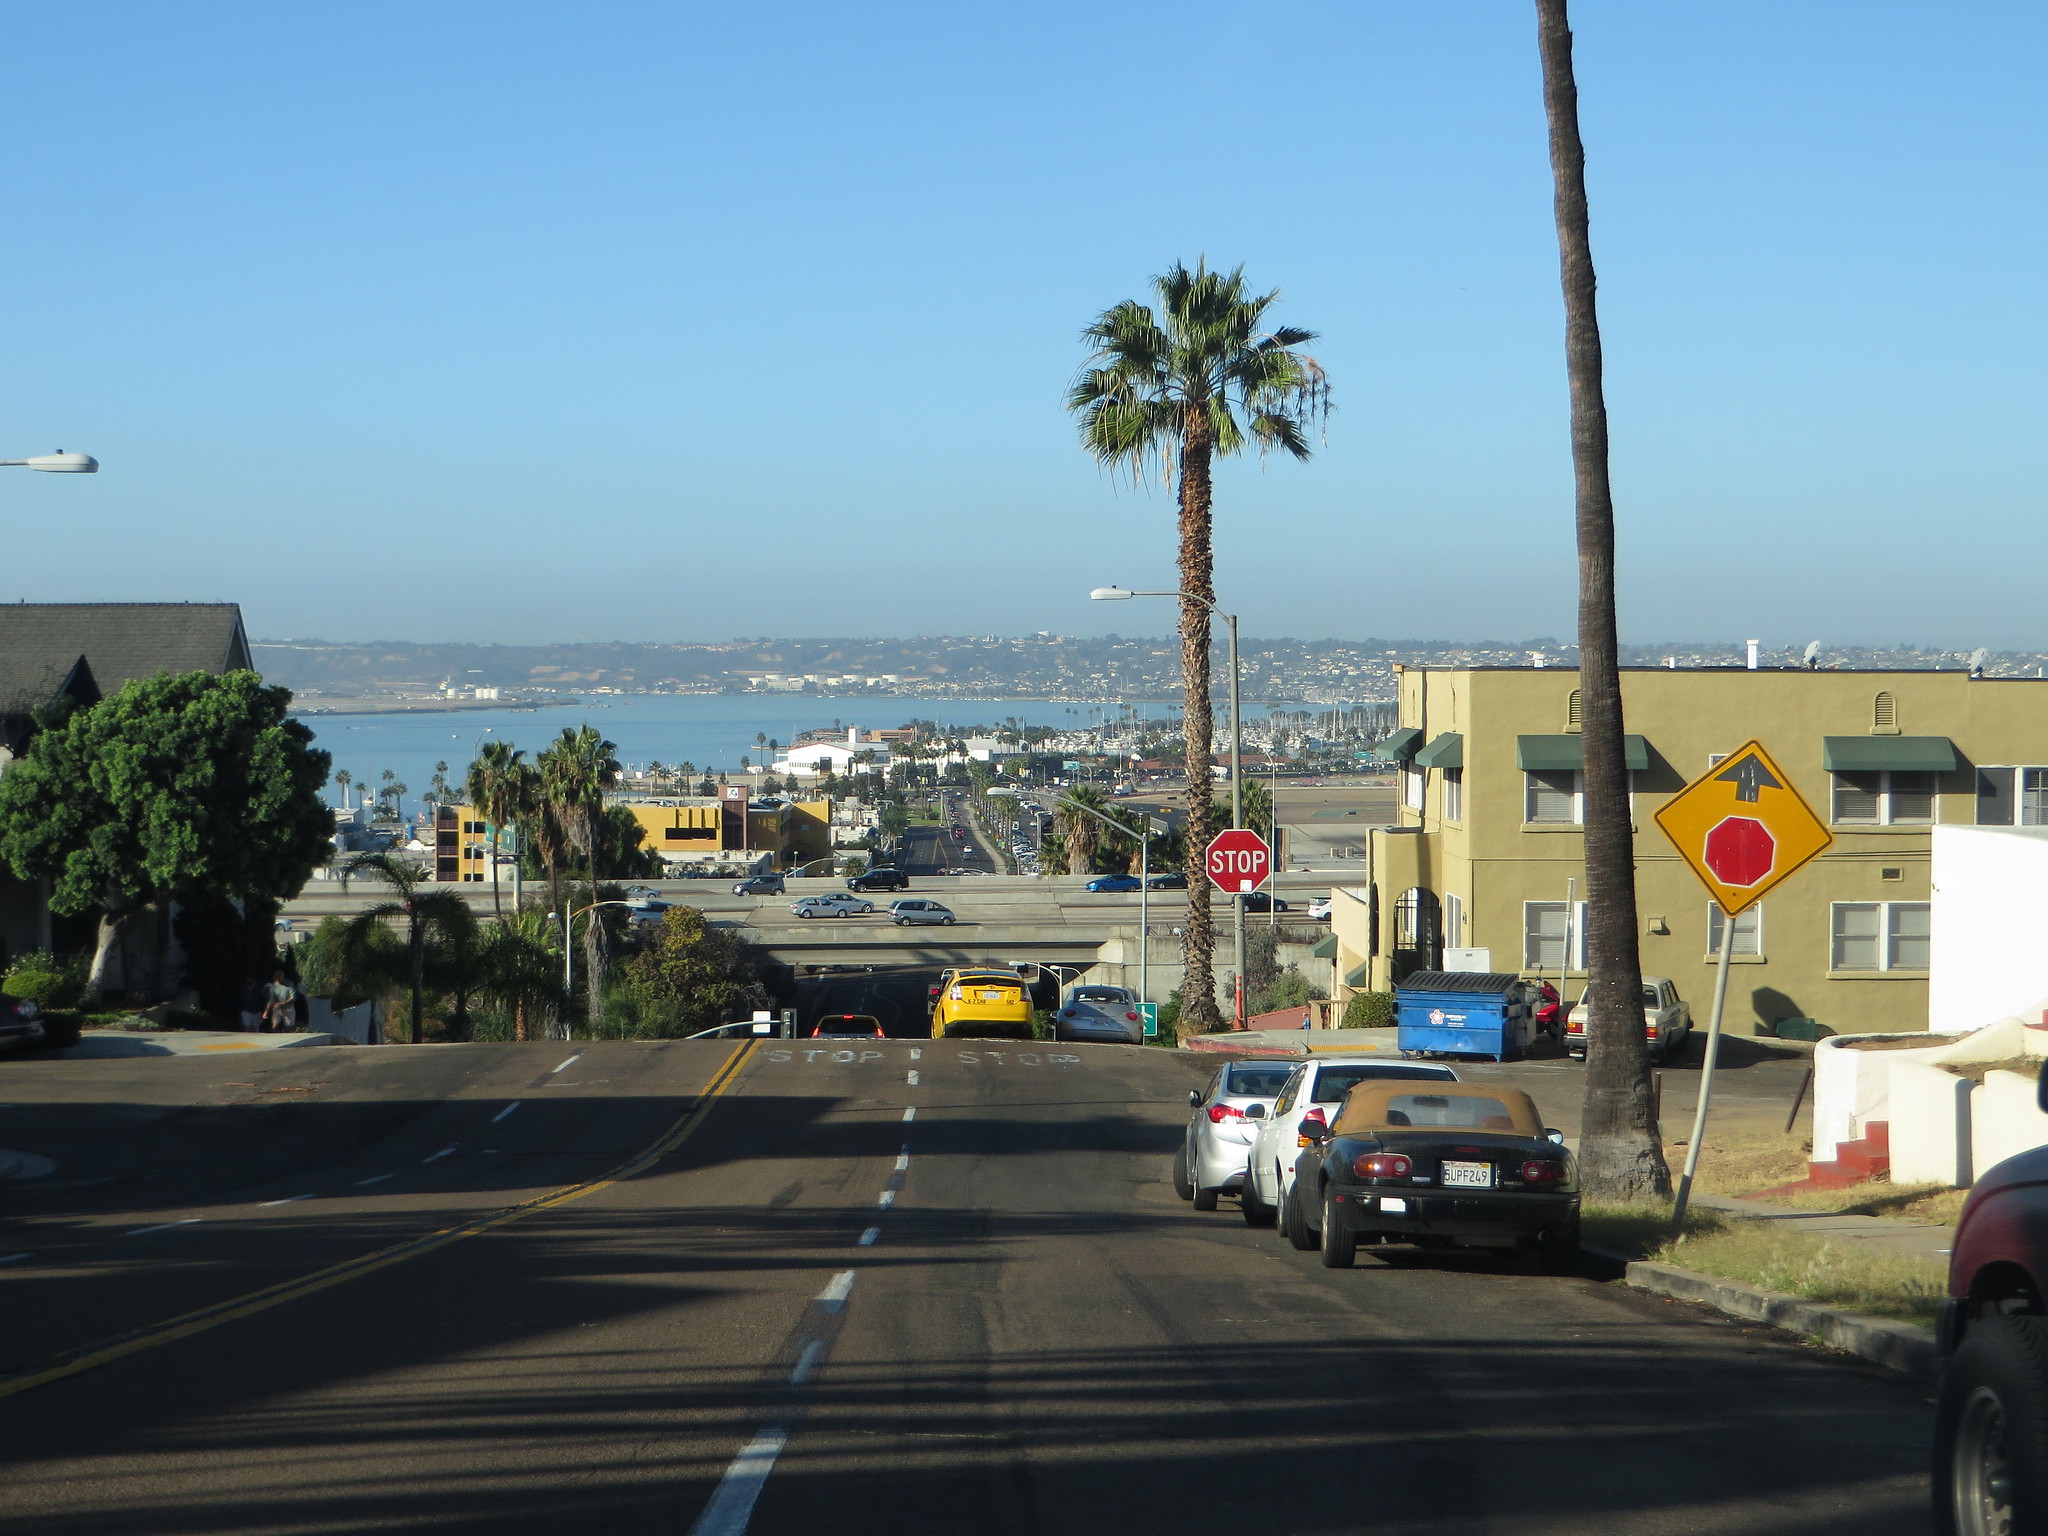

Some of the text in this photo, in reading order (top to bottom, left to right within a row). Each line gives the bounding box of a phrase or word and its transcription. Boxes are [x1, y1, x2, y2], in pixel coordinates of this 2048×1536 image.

[1211, 850, 1266, 873] STOP
[767, 1050, 887, 1063] STOP
[957, 1051, 1081, 1066] STOP
